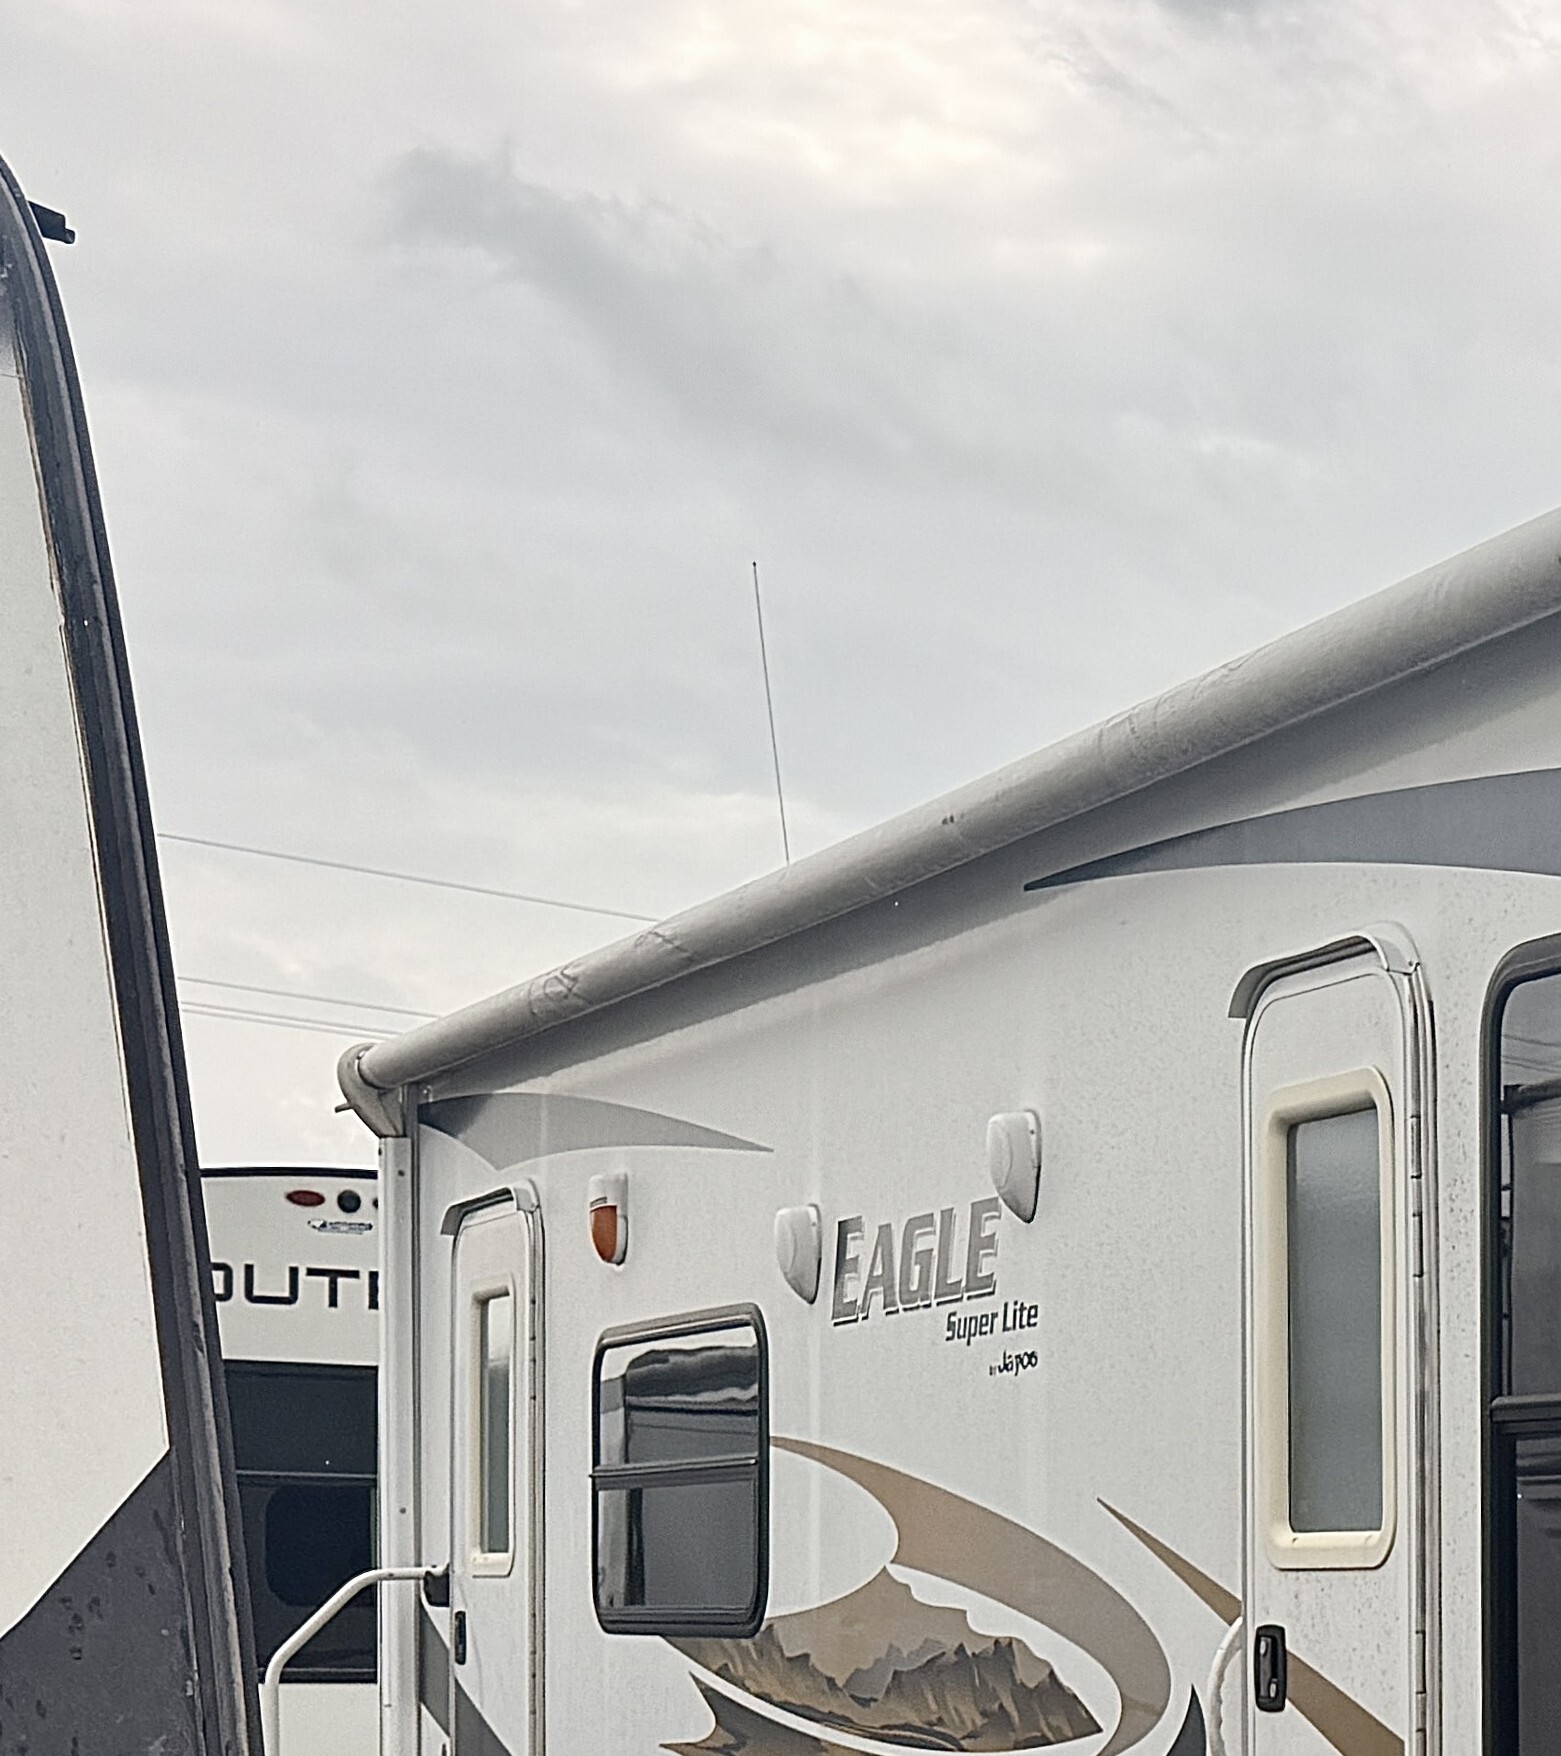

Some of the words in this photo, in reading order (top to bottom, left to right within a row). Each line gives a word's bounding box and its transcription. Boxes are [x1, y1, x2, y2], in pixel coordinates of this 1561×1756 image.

[832, 1196, 1002, 1327] EAGLE
[946, 1310, 998, 1346] Super
[1002, 1300, 1038, 1332] Lite
